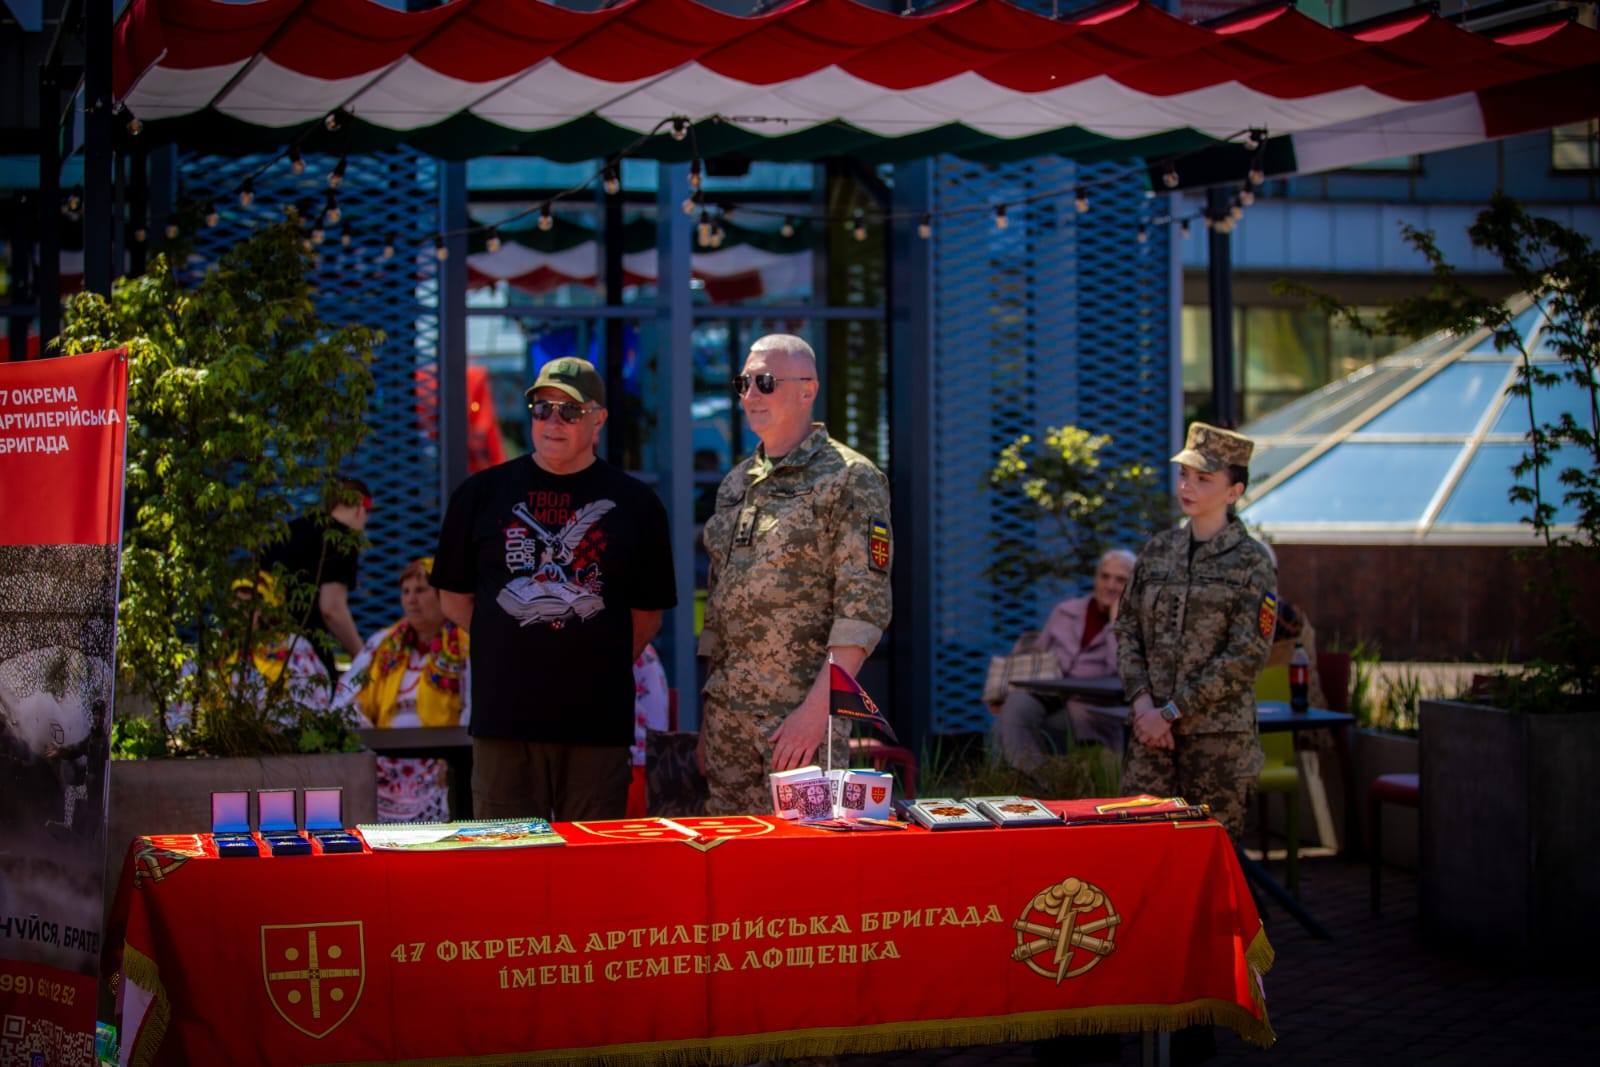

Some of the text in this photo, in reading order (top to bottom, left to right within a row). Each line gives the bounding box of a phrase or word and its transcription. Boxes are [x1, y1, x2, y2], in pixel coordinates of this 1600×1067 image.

[12, 386, 78, 405] ОКРЕМА
[0, 406, 120, 430] АРТИЛЕРІЙСЬКА
[0, 435, 69, 454] БРИГАДА
[528, 491, 571, 507] ТВОЯ
[391, 904, 1004, 962] 47 ОКРЕМА АРТИЛЕРІЙСЬКА БРИГАДА
[499, 940, 901, 989] ІМЕНІ СЕМЕНА ЛОЩЕНКА
